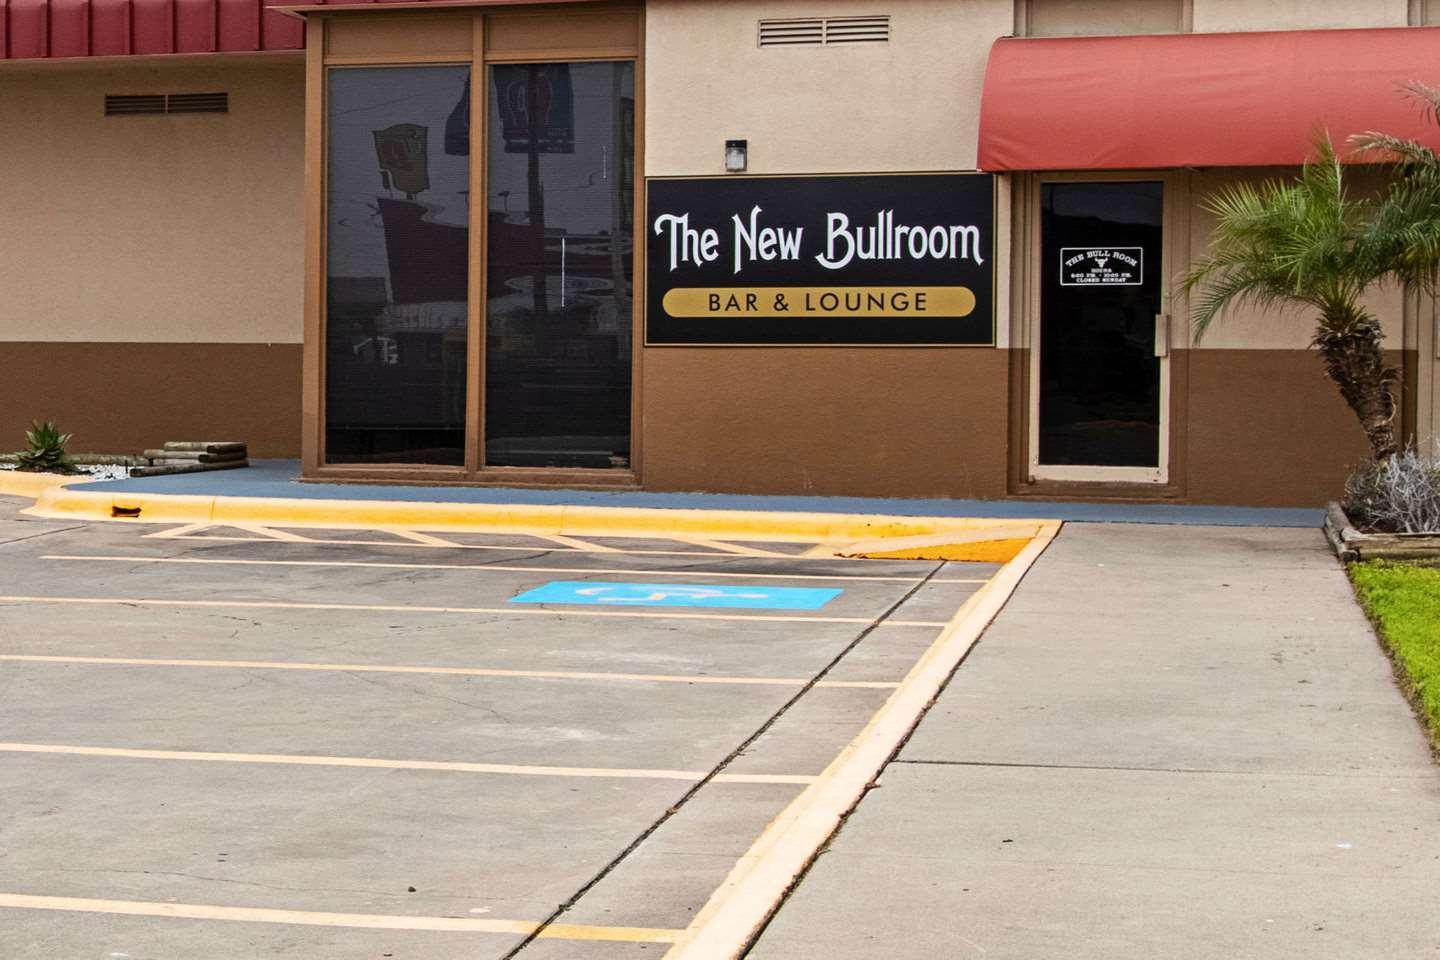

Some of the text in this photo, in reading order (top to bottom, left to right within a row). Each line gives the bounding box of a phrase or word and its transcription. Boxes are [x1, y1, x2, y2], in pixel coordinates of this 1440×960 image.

[654, 204, 985, 275] The New Bullroom
[1065, 250, 1138, 267] THE BULL ROOM
[709, 292, 928, 312] BAR & LOUNGE
